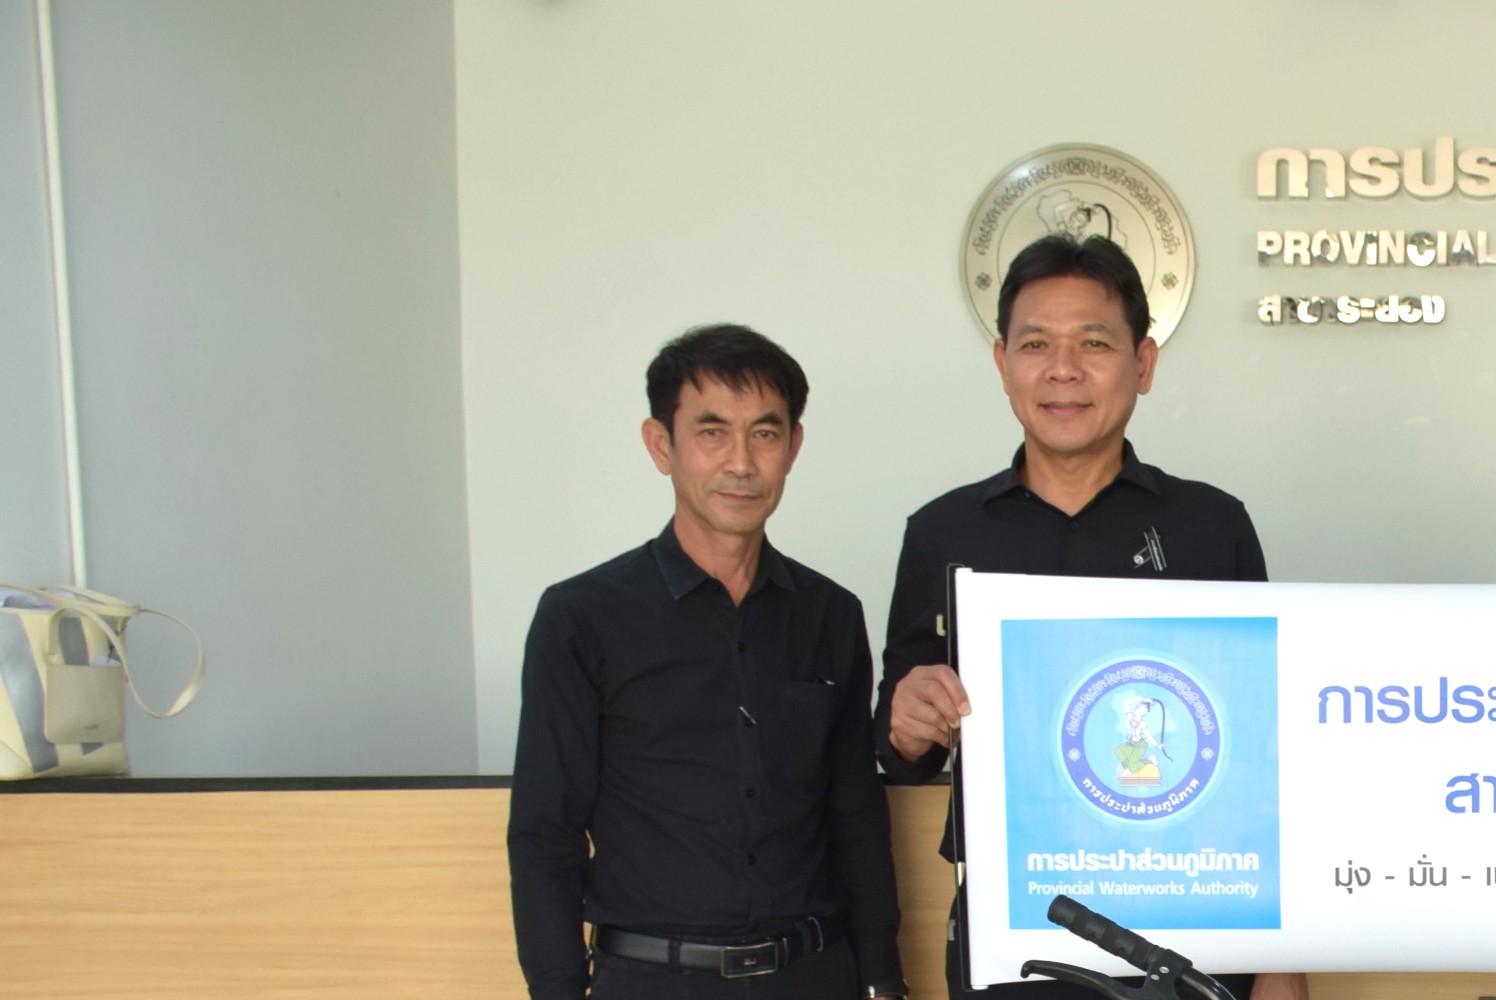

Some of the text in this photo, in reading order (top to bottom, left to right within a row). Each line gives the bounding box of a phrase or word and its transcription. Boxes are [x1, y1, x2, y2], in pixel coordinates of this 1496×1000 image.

[1257, 293, 1446, 326] สาขาระยอง
[1081, 776, 1200, 815] การประปาส่วนภูมิภาค
[1027, 847, 1260, 877] การประปาส่วนภูมิภาค
[1334, 861, 1372, 895] มุ่ง
[1408, 854, 1448, 888] มั่น
[1028, 881, 1259, 898] Provincial Waterworks Authority
